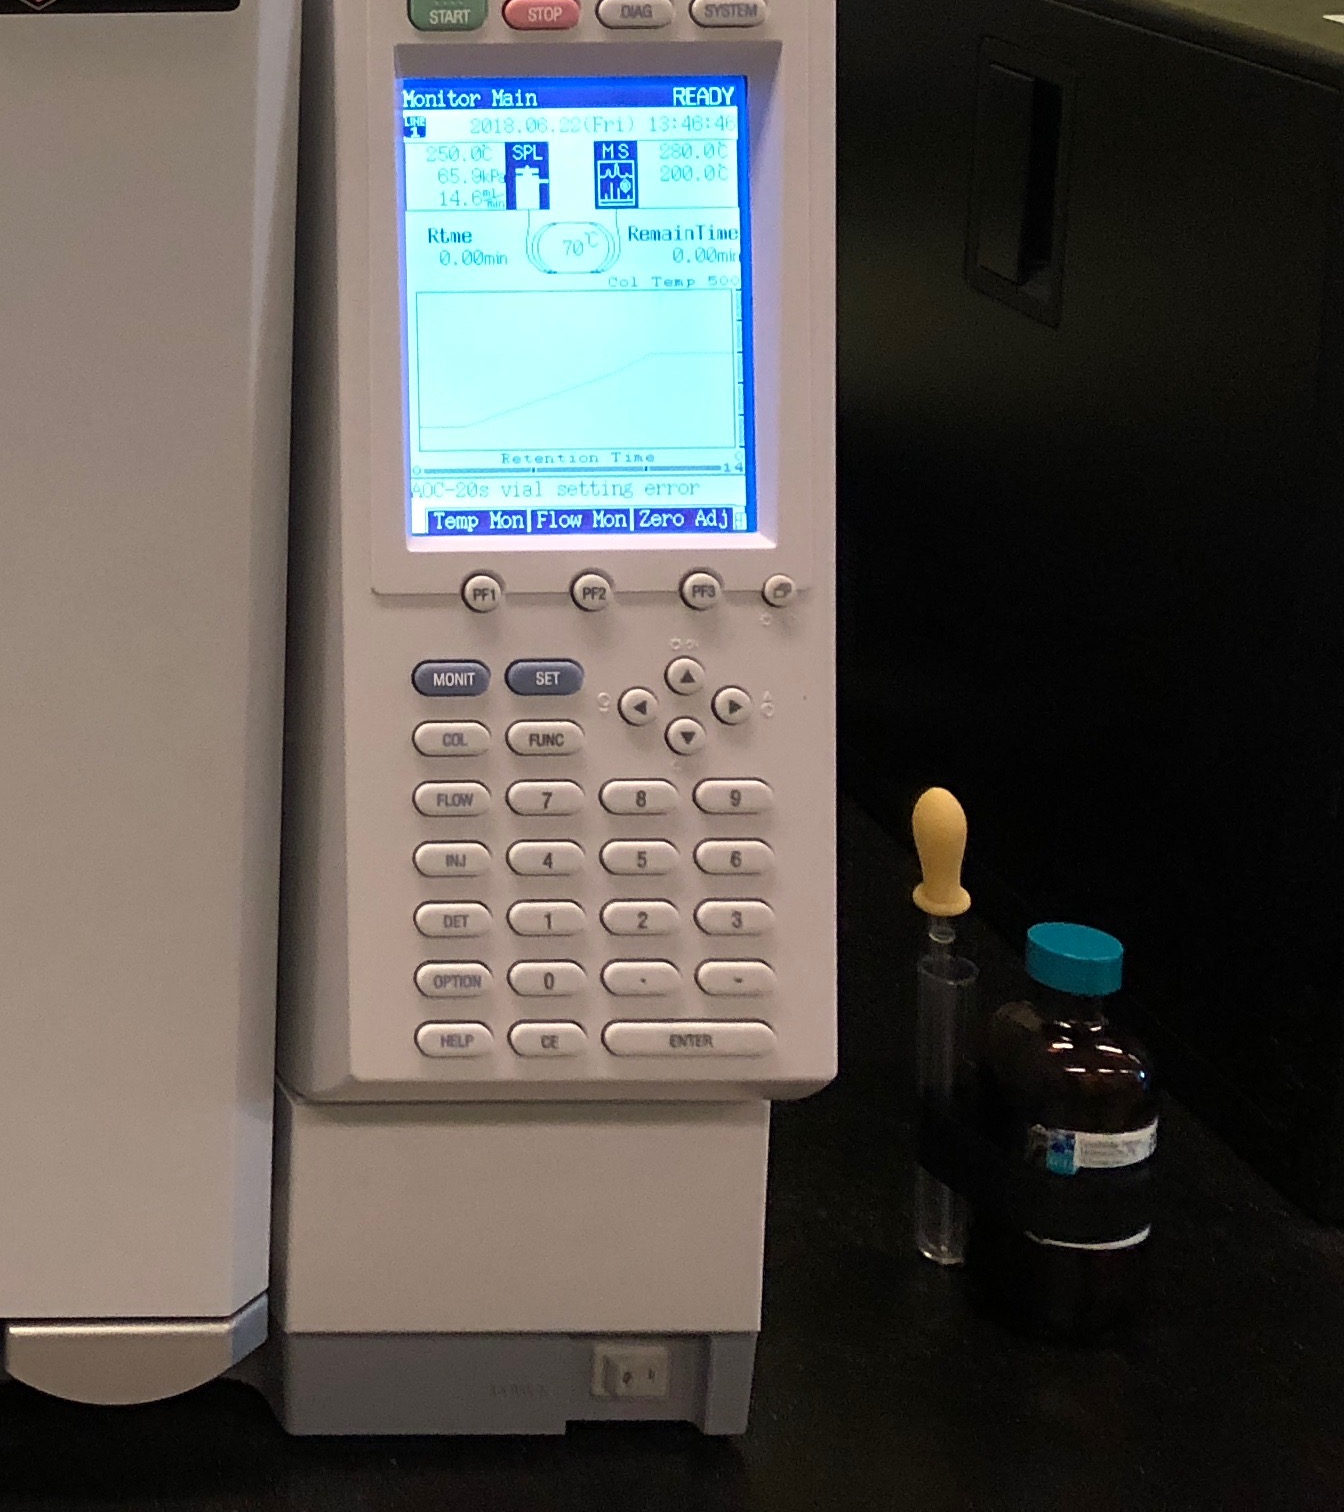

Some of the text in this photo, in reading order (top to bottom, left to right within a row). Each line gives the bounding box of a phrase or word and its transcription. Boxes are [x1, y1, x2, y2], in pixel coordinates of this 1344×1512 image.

[429, 9, 471, 25] START
[527, 7, 562, 23] STOP
[621, 3, 653, 19] DIAG
[704, 2, 758, 19] SYSTEM
[403, 88, 538, 109] Monitor Main
[673, 85, 735, 107] READY
[512, 145, 543, 161] SPL
[439, 249, 509, 266] 0.00min
[608, 275, 638, 288] Col
[652, 275, 696, 289] Temp
[501, 450, 655, 465] Retention Time
[411, 479, 700, 500] AOC-20s vial setting error
[433, 508, 729, 531] Temp Mon Flow Mon Zero Adj
[473, 587, 496, 602] PF1
[582, 586, 607, 601] PF2
[691, 584, 716, 599] PF3
[433, 672, 474, 687] MONIT
[535, 671, 561, 686] SET
[443, 732, 468, 747] COL
[529, 732, 565, 748] FUNC
[437, 792, 473, 808] FLOW
[542, 792, 553, 810] 7
[635, 791, 647, 808] 8
[729, 789, 741, 807] 9
[445, 853, 467, 868] INJ
[543, 851, 554, 869] 4
[636, 851, 647, 868] 5
[730, 850, 742, 867] 6
[443, 914, 470, 929] DET
[544, 913, 553, 930] 1
[637, 912, 649, 929] 2
[730, 911, 743, 929] 3
[433, 974, 482, 989] OPTION
[543, 972, 555, 990] 0
[440, 1034, 474, 1048] HELP
[540, 1034, 559, 1049] CE
[669, 1033, 713, 1049] ENTER
